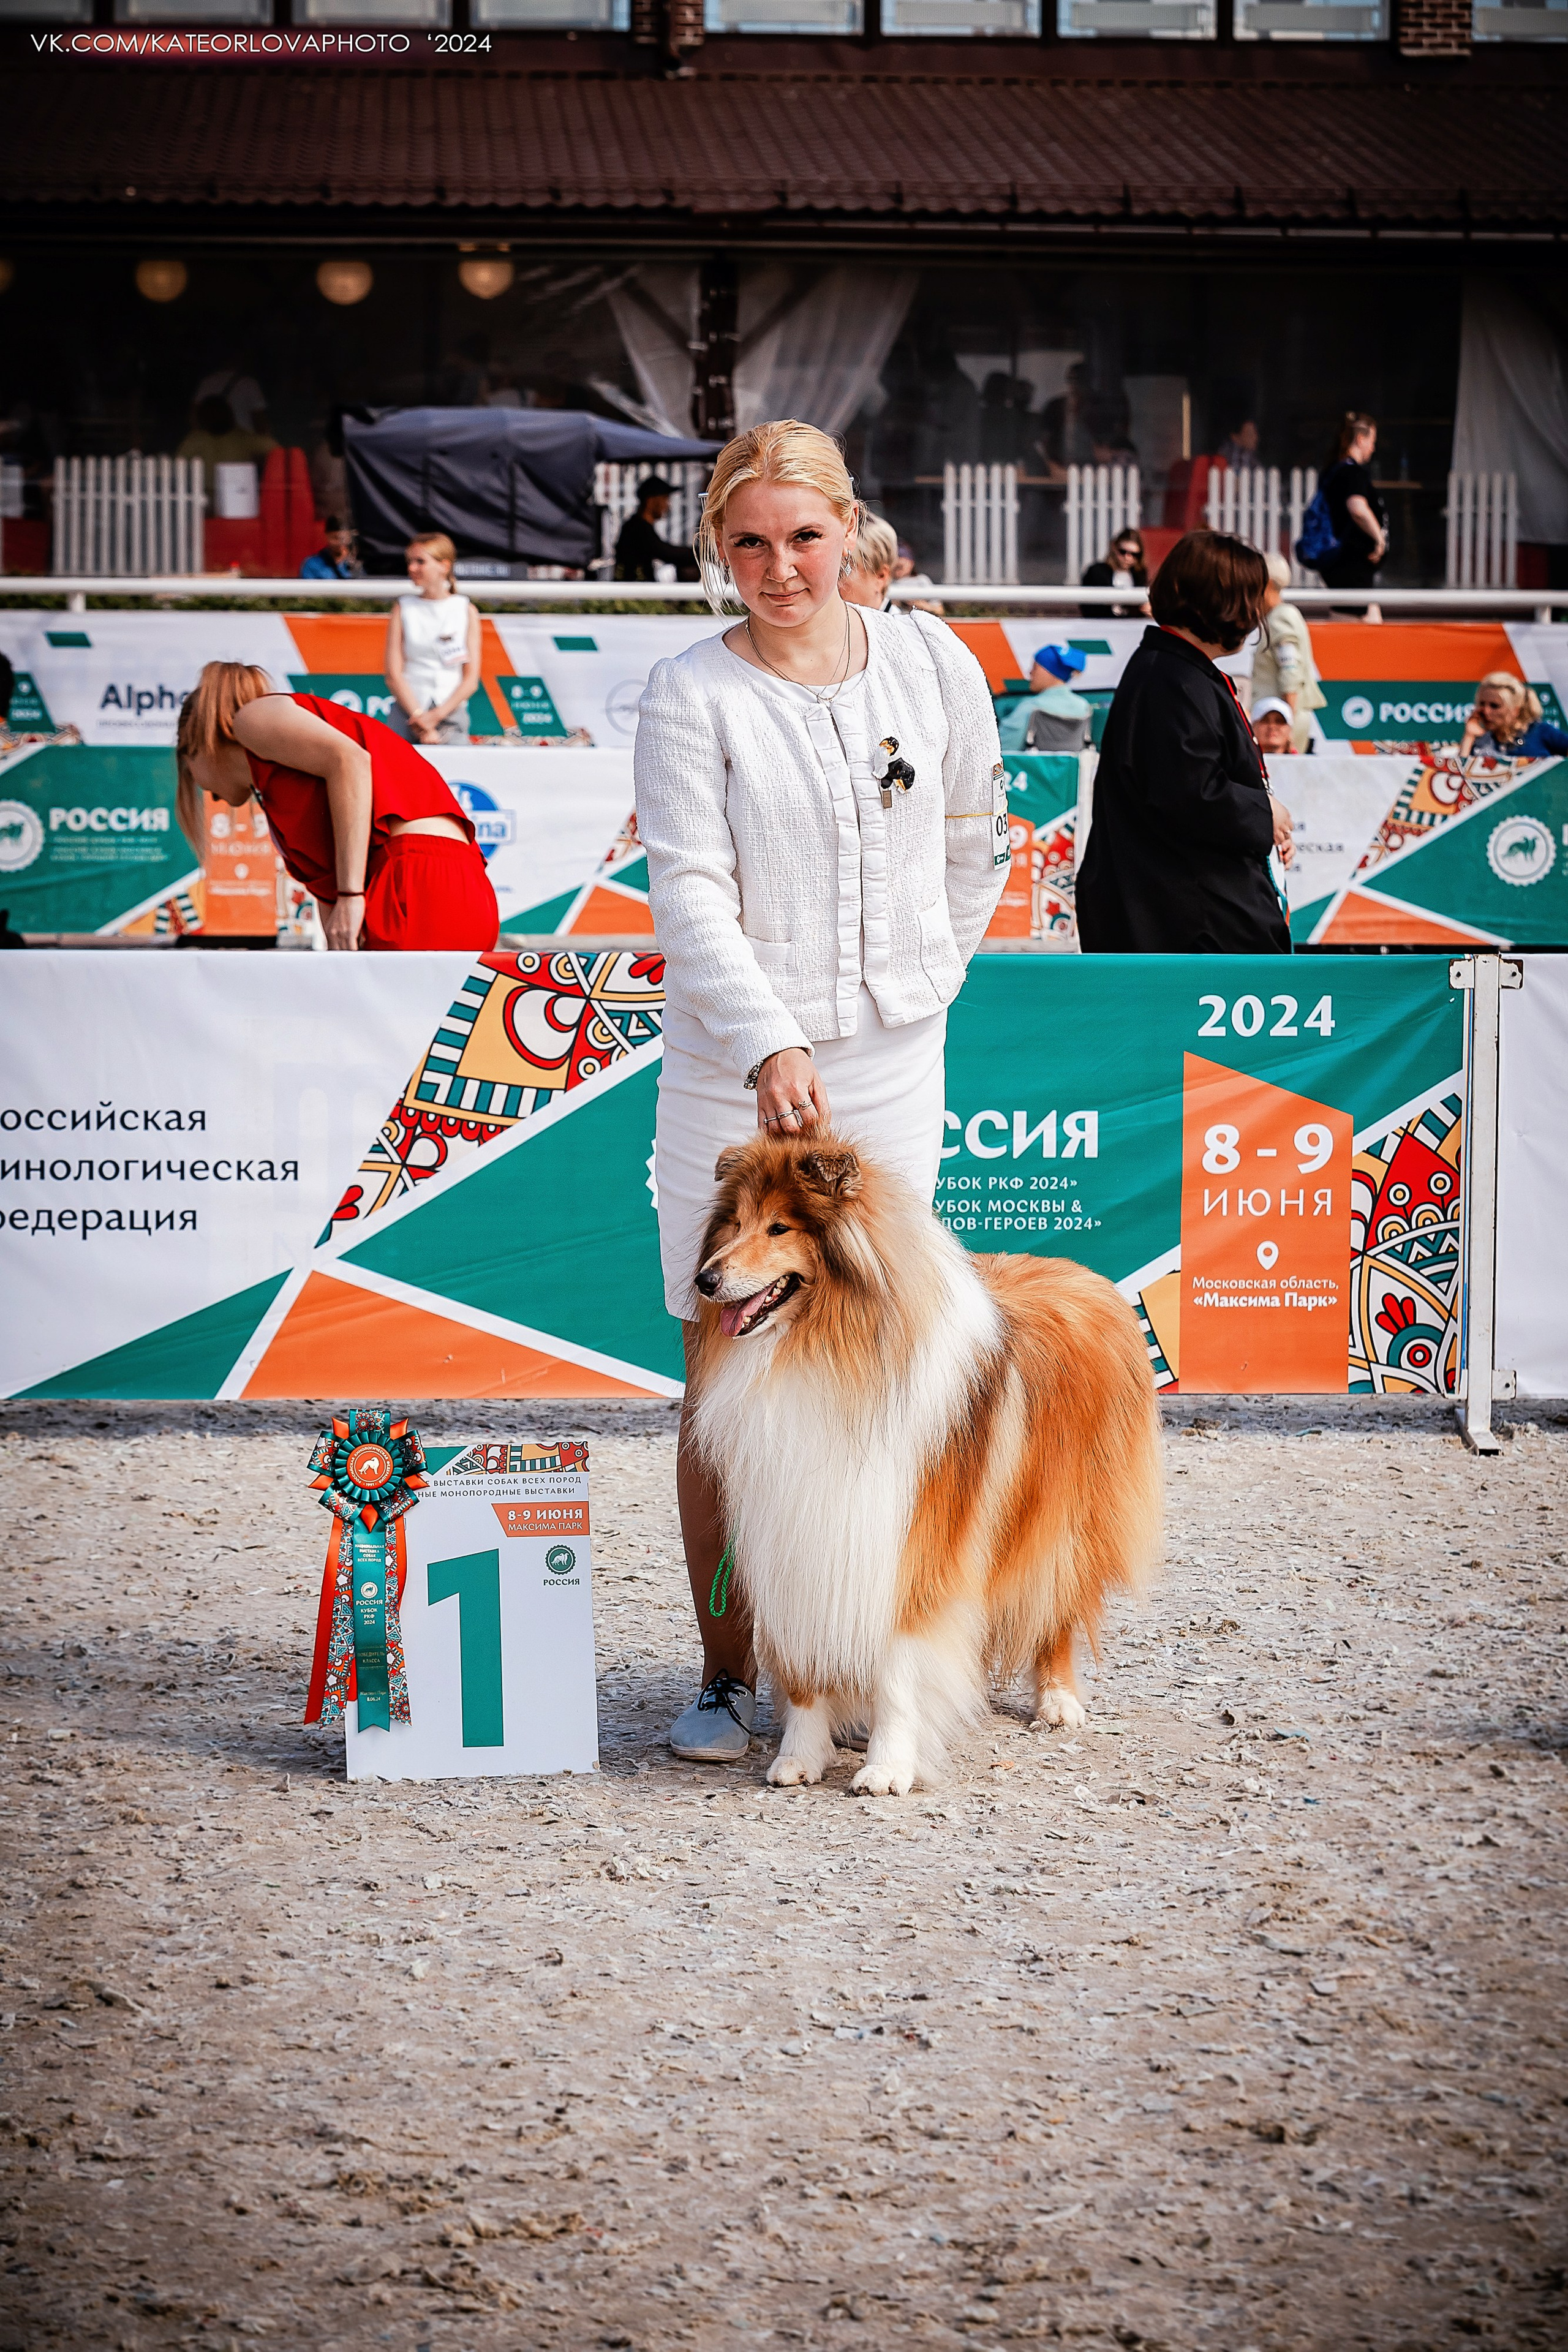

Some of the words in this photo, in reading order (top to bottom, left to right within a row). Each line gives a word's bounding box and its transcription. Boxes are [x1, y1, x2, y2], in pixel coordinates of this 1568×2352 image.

[49, 807, 170, 832] РОССИЯ
[1197, 995, 1335, 1037] 2024
[0, 1101, 206, 1131] оссийская
[1202, 1123, 1241, 1175] 8
[1294, 1123, 1334, 1175] 9
[0, 1159, 299, 1181] инологическая
[988, 1177, 1024, 1189] РКФ
[1029, 1177, 1078, 1190] 2024»
[987, 1199, 1065, 1213] МОСКВЫ
[1071, 1199, 1083, 1213] &
[1203, 1188, 1332, 1216] ИЮНЯ
[1053, 1216, 1102, 1231] 2024»
[1193, 1276, 1276, 1289] Московская
[1280, 1275, 1339, 1290] область,
[1193, 1292, 1281, 1308] «Максима
[1284, 1292, 1338, 1311] Парк»
[549, 1476, 582, 1485] ПОРОД
[508, 1510, 532, 1521] 8-9
[537, 1509, 582, 1520] ИЮНЯ
[559, 1522, 583, 1531] ПАРК
[543, 1578, 580, 1586] РОССИЯ
[427, 1548, 504, 1748] 1
